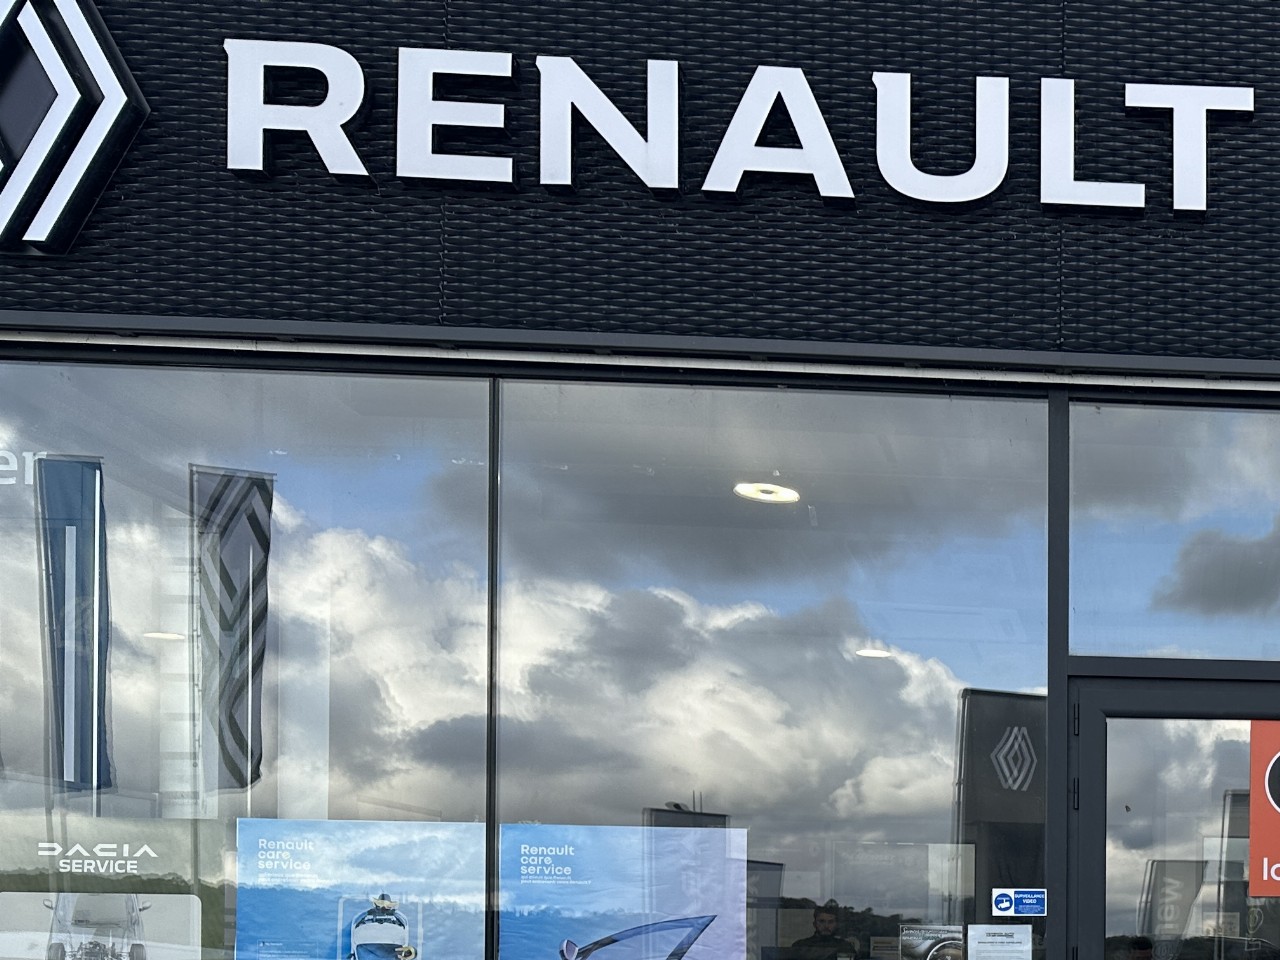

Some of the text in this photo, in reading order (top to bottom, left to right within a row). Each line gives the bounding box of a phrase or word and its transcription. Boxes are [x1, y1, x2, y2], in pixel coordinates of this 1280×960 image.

[223, 38, 1255, 212] RENAULT
[38, 842, 158, 858] DACIA
[259, 839, 314, 850] Renault
[521, 844, 574, 856] Renault
[258, 851, 291, 860] care
[521, 856, 552, 865] care
[59, 860, 138, 873] SERVICE
[258, 859, 311, 871] service
[520, 864, 572, 875] service
